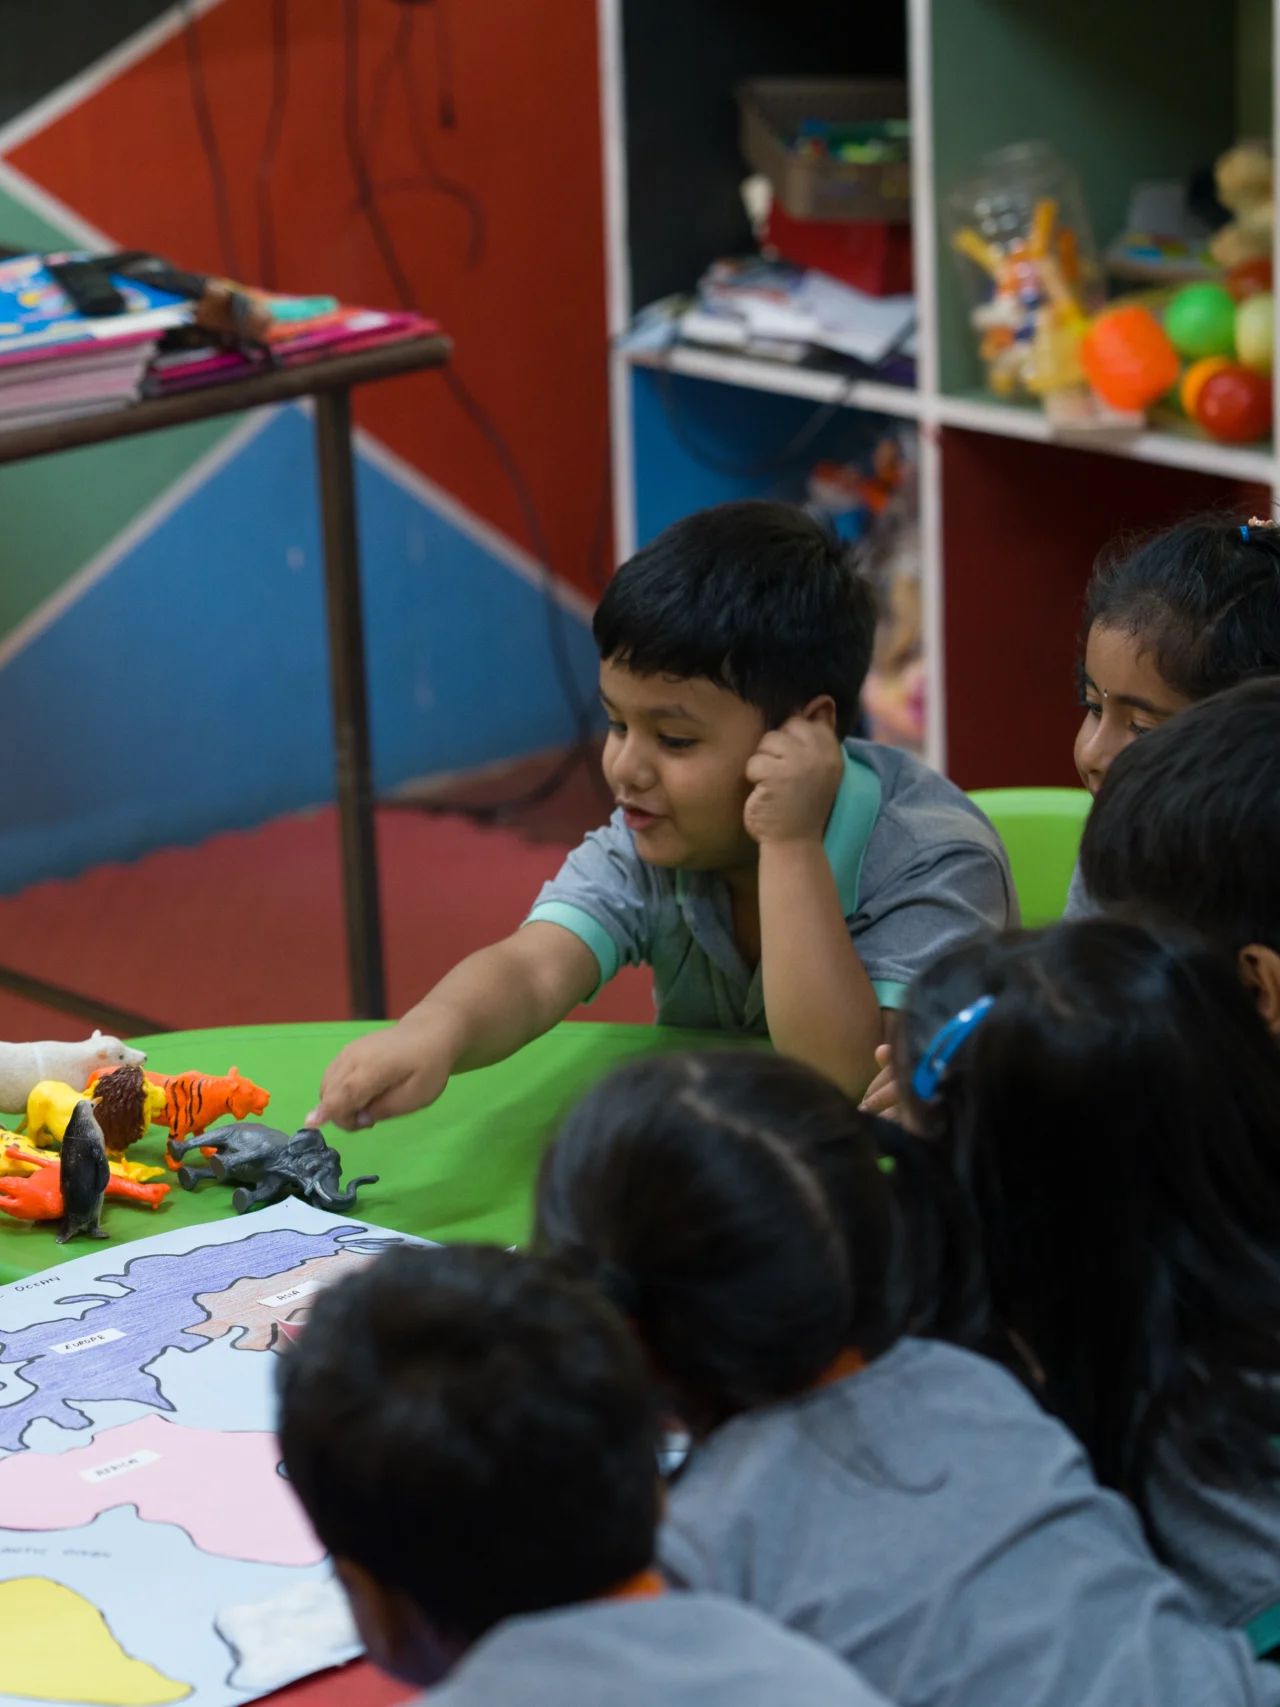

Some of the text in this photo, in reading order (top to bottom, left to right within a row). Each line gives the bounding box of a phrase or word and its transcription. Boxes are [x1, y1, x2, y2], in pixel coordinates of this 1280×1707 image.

[14, 1275, 61, 1292] OCEAN
[277, 1289, 300, 1301] ASIA
[64, 1334, 106, 1350] EUROPE
